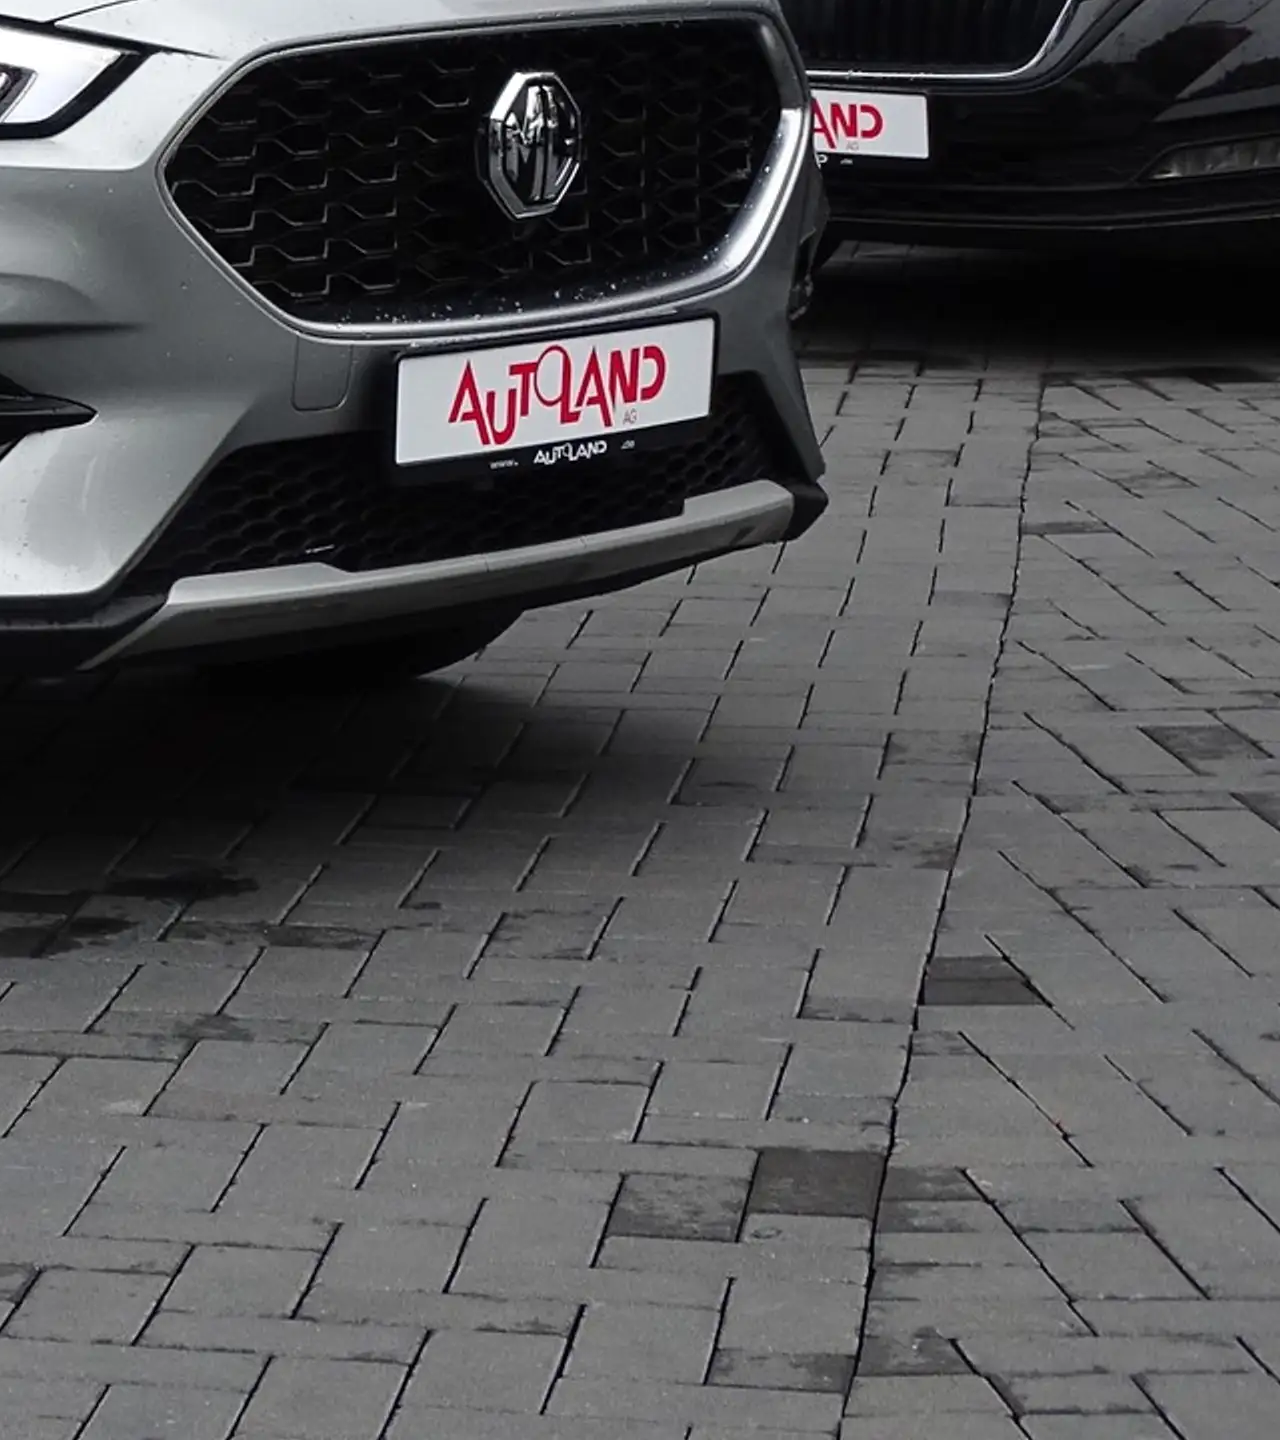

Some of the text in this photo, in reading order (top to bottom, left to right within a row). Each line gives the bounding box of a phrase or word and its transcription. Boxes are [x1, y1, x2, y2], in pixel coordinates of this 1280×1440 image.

[810, 95, 884, 149] AND
[448, 344, 667, 446] AUTOLAND
[533, 440, 608, 466] AUTOLAND
